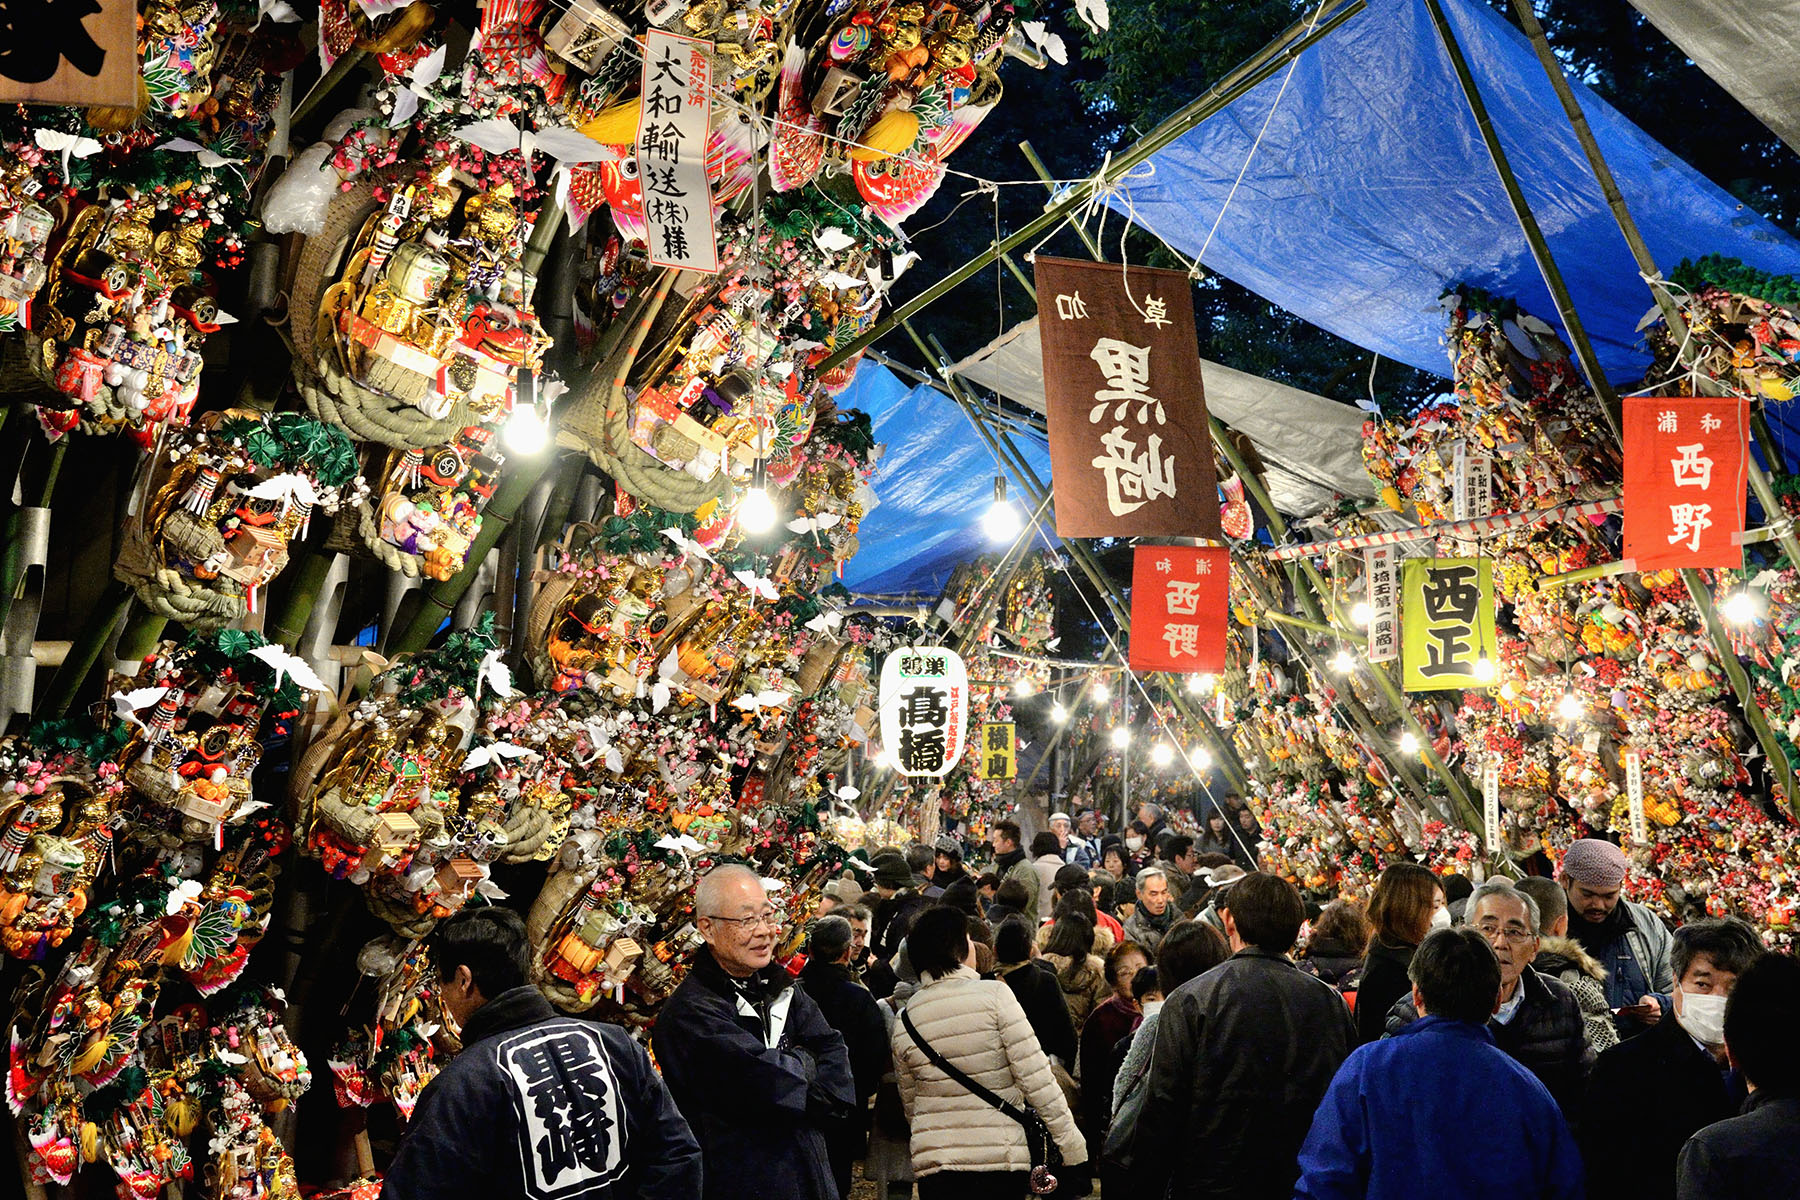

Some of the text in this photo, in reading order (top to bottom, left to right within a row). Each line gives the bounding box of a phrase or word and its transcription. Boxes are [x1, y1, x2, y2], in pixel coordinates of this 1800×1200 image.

[641, 45, 690, 260] 大和輸送(株)様
[1657, 410, 1722, 434] 浦和
[1667, 442, 1714, 552] 西野
[1418, 565, 1482, 678] 西正
[901, 657, 945, 676] 巣鴨
[987, 726, 1008, 777] 横山
